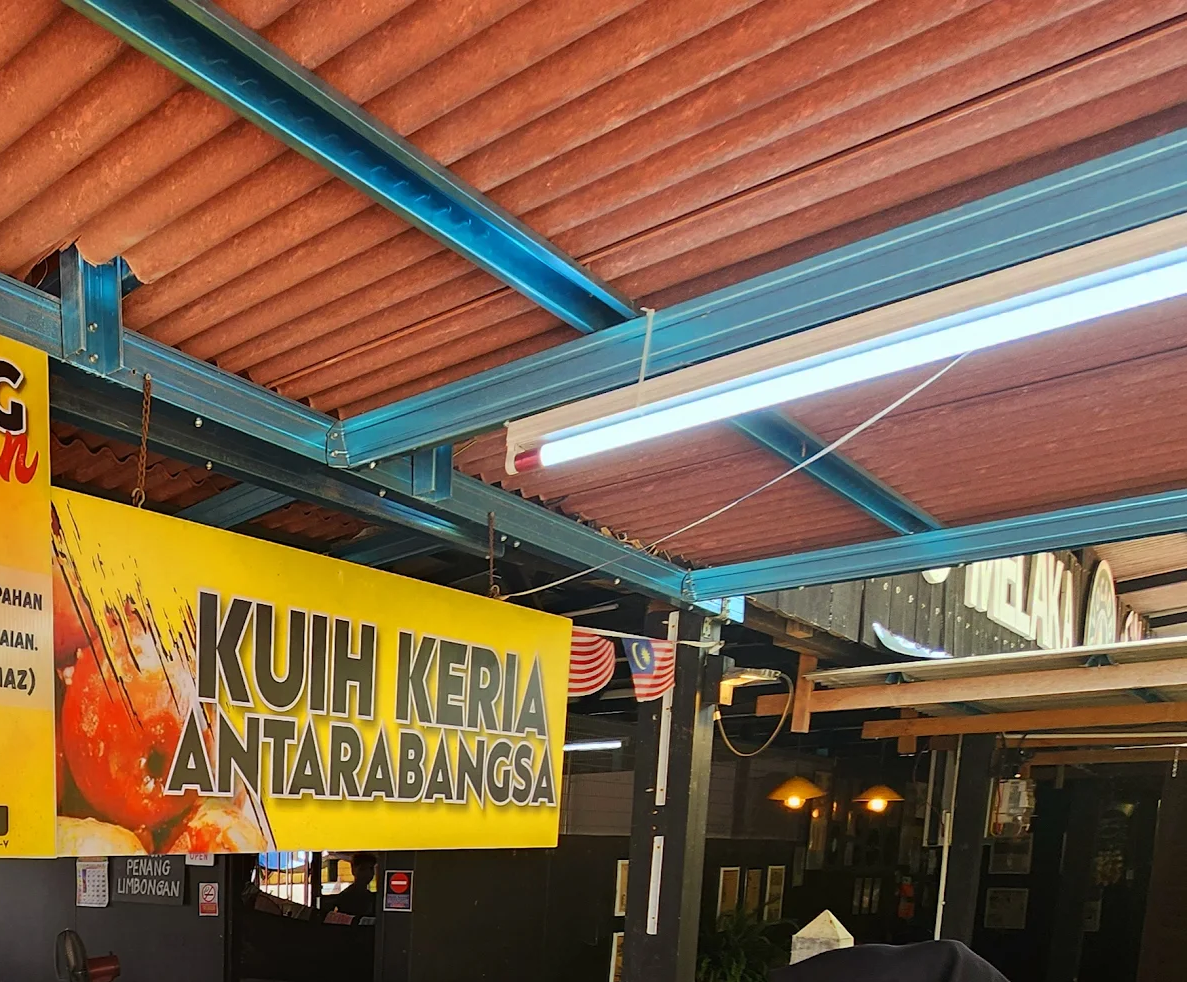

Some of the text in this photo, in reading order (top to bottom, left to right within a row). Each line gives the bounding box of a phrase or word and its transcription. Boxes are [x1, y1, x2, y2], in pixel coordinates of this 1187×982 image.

[197, 589, 548, 740] KUIH KERIA
[164, 703, 557, 810] ANTARABANGSA
[117, 878, 180, 897] LIMBONGAN
[126, 859, 171, 876] PENANG
